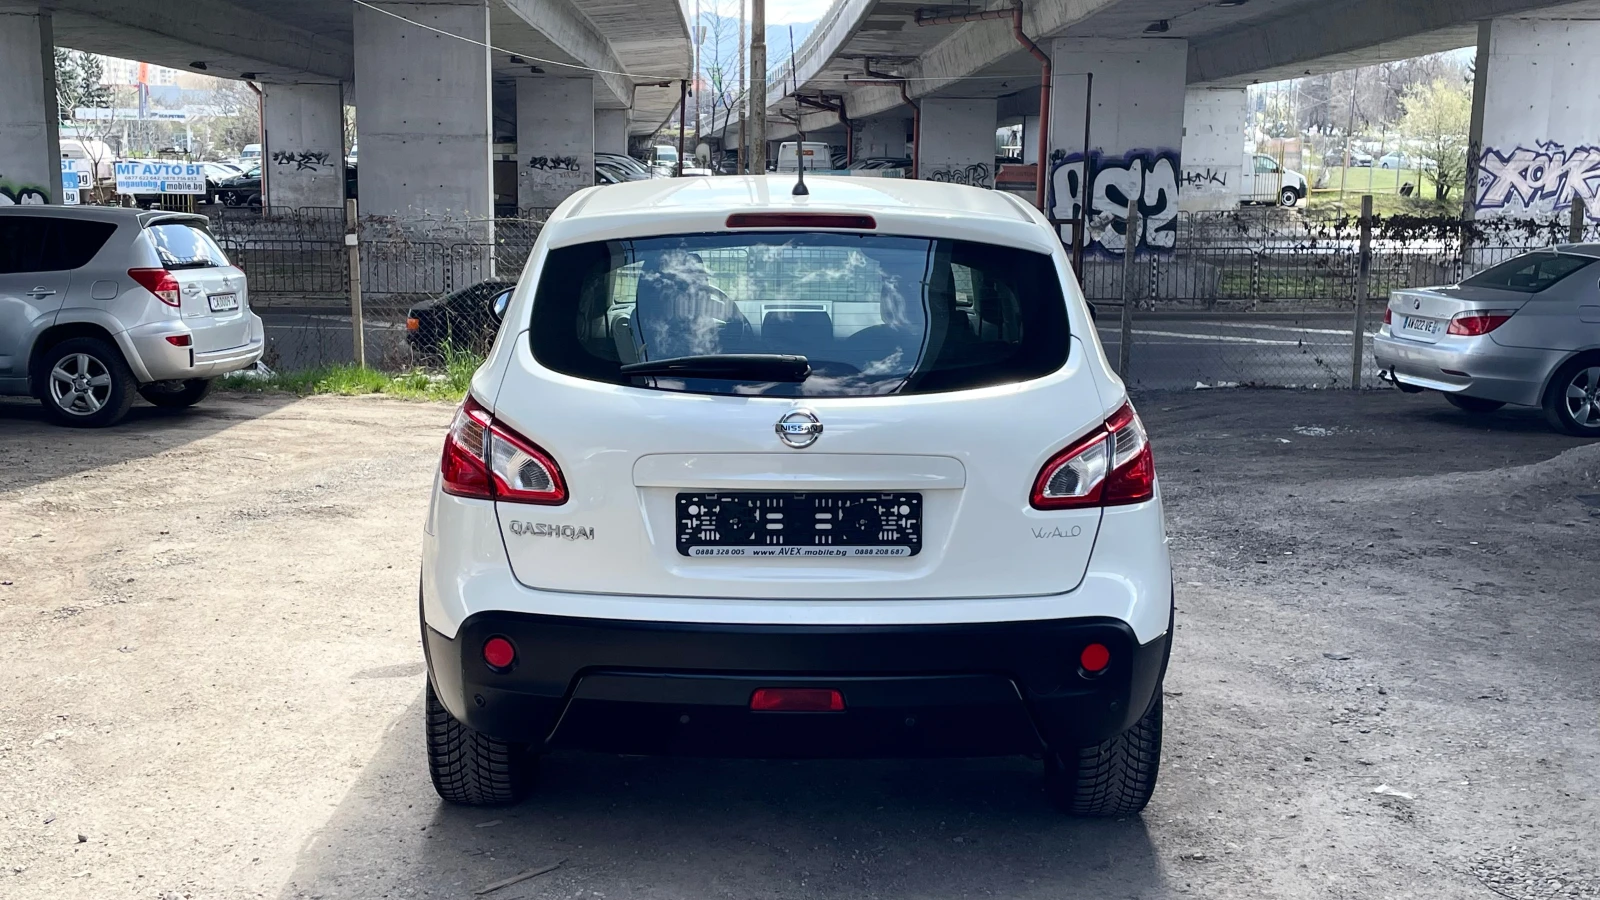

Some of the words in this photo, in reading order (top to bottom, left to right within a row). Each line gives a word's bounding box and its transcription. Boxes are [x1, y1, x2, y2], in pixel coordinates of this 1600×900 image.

[117, 164, 139, 175] МГ
[142, 164, 182, 175] АУТО
[186, 165, 204, 175] БГ
[166, 182, 203, 191] mobile.bg
[780, 424, 818, 432] NISSAN
[508, 519, 595, 541] QASHQAI
